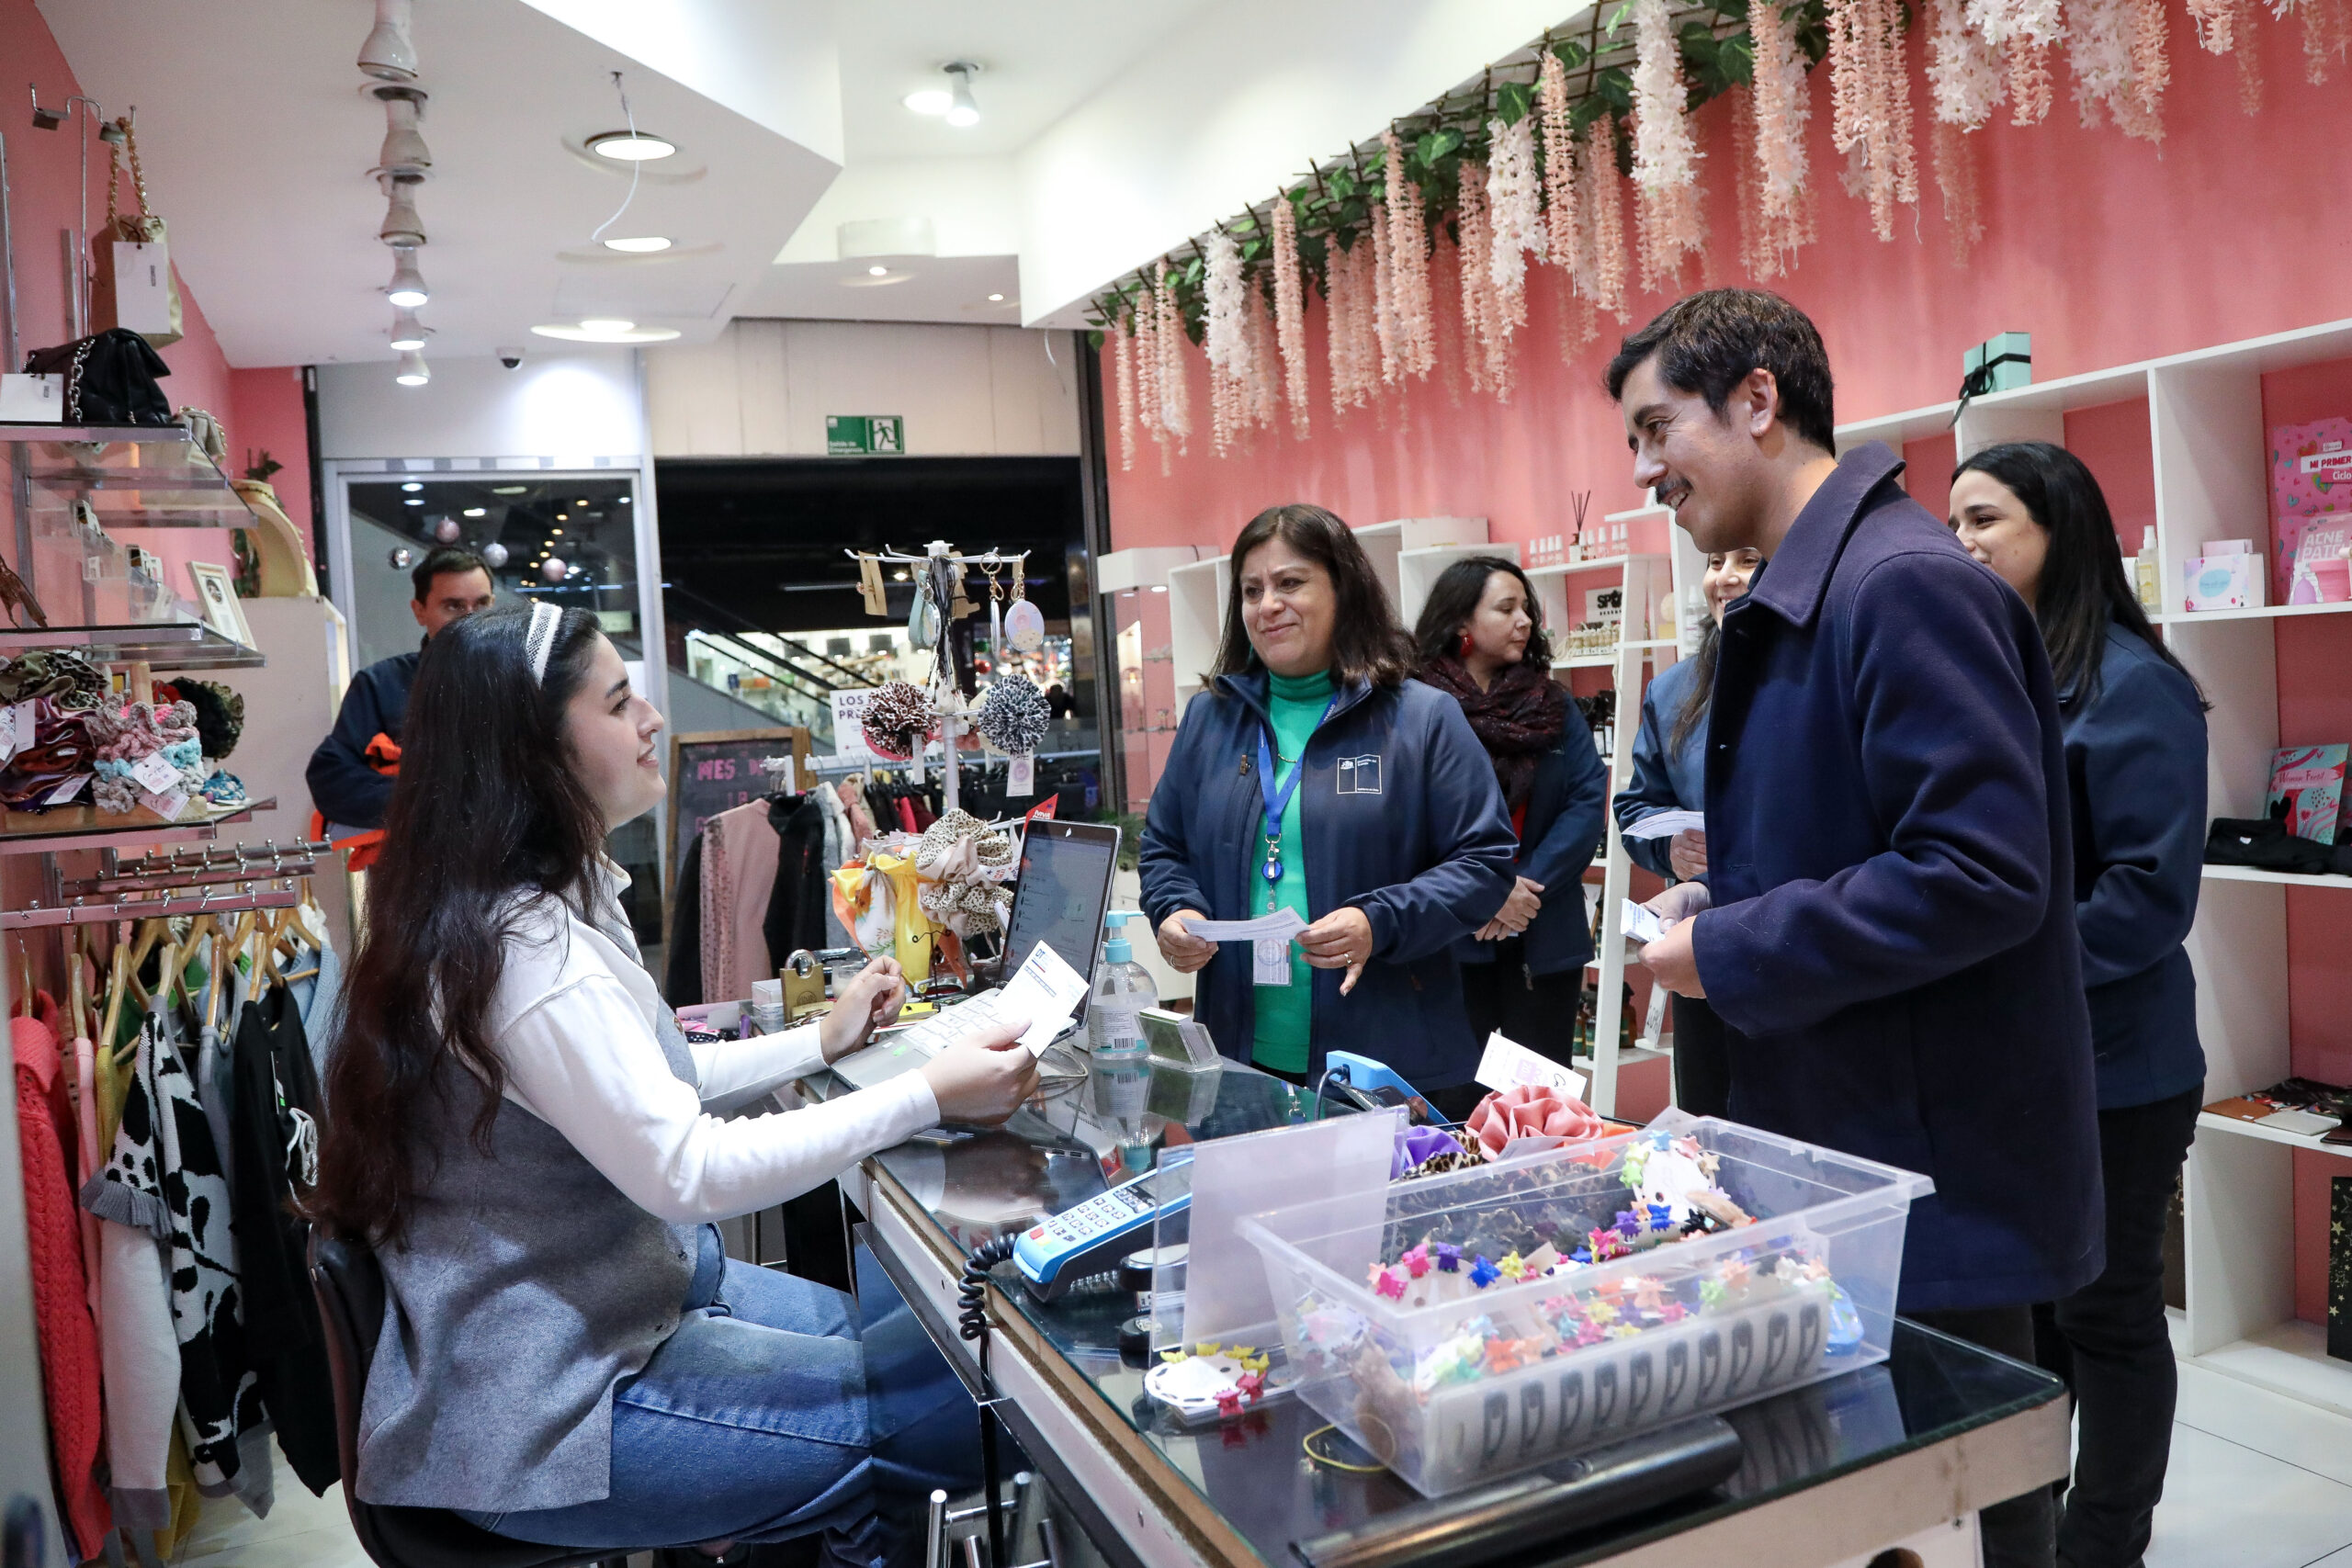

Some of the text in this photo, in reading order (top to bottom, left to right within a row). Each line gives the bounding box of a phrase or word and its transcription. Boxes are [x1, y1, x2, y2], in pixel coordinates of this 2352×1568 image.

[2322, 456, 2352, 467] PRIMER
[2333, 470, 2352, 480] Ciclo
[2305, 530, 2346, 546] ACNE
[2301, 544, 2346, 560] PATC
[839, 695, 864, 706] LOS
[697, 759, 736, 781] MES
